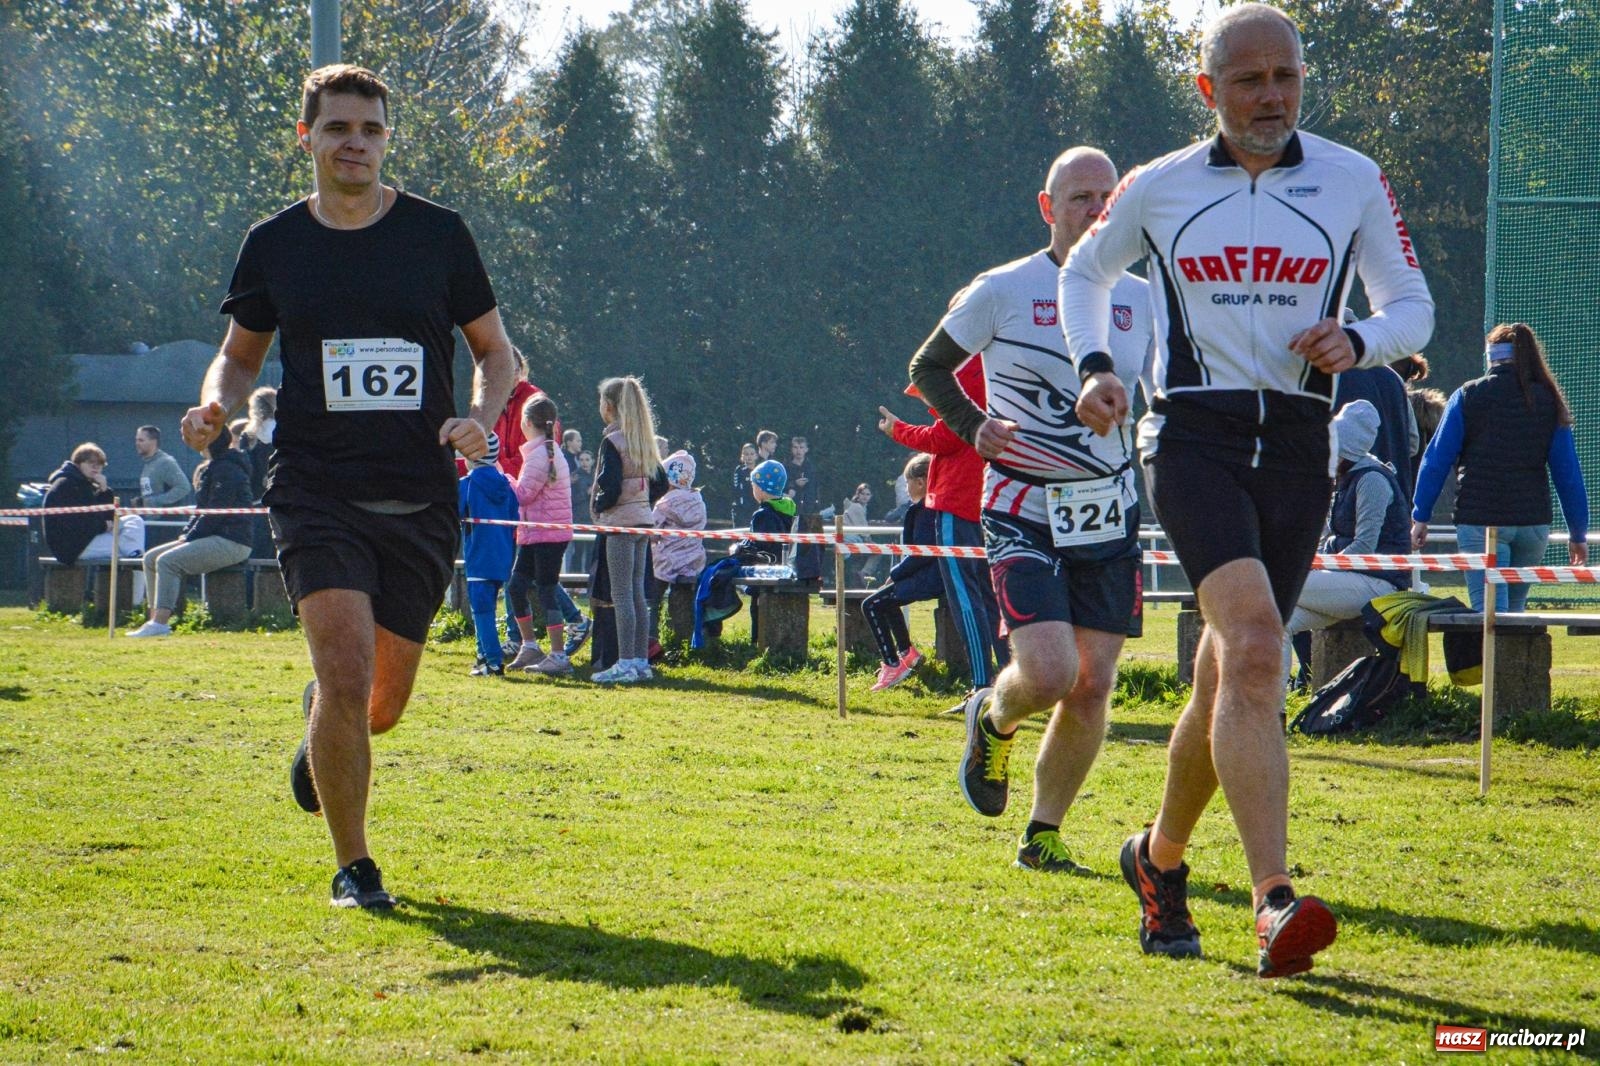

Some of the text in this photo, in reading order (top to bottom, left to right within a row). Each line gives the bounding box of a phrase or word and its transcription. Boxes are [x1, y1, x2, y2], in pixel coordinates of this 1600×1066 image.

[1177, 246, 1329, 284] RAFAKO
[1268, 294, 1298, 306] PBG
[332, 365, 417, 397] 162
[1054, 499, 1121, 534] 324
